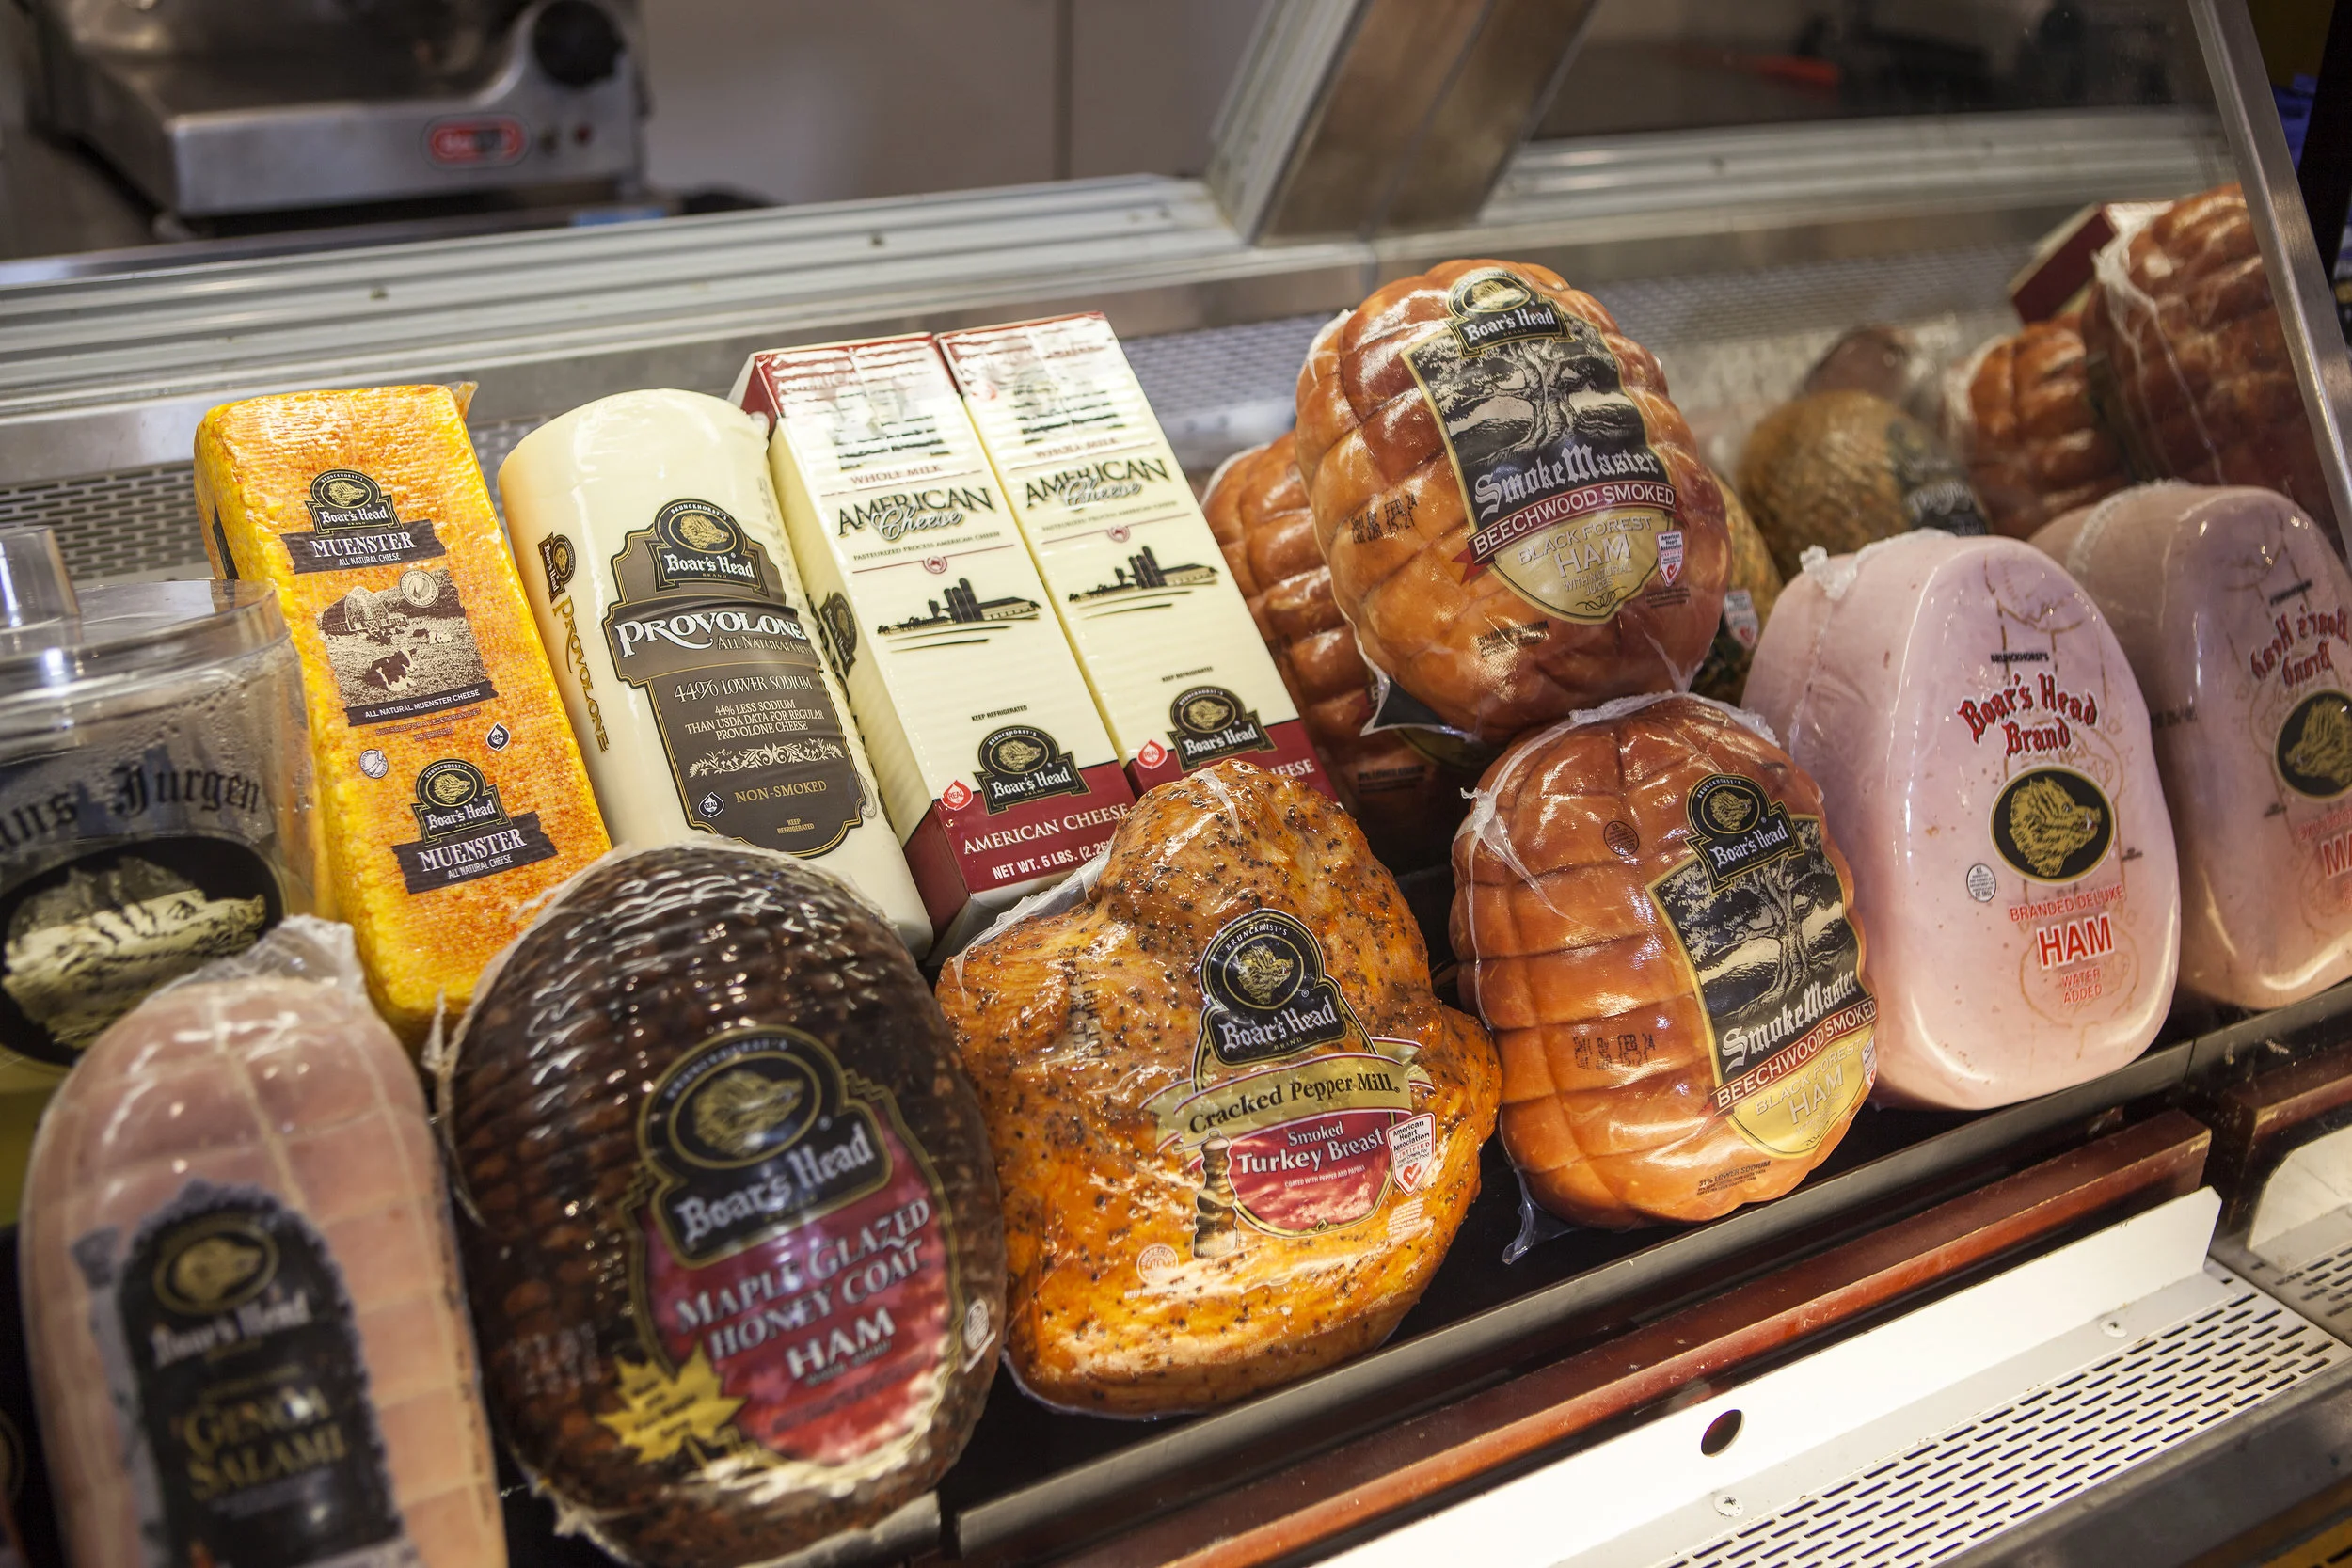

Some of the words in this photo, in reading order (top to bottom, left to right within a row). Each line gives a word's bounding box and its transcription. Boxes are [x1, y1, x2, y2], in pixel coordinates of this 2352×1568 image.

[1464, 314, 1515, 342] Boar's
[1515, 308, 1555, 326] Head
[850, 470, 901, 484] WHOLE
[907, 464, 943, 476] MILK
[1025, 458, 1172, 509] AMERICAN
[1475, 444, 1659, 520] SmokeMaster
[320, 509, 358, 524] Boar's
[358, 507, 389, 520] Head
[838, 487, 995, 536] AMERICAN
[871, 505, 962, 541] Cheese
[1474, 490, 1598, 555] BEECHWOOD
[1602, 483, 1676, 508] SMOKED
[310, 531, 417, 558] MUENSTER
[853, 546, 902, 561] PASTEURIZED
[902, 541, 935, 552] PROCESS
[1517, 530, 1578, 565] BLACK
[1581, 516, 1652, 541] FOREST
[1553, 533, 1632, 578] HAM
[339, 557, 350, 566] ALL
[351, 555, 378, 565] NATURAL
[378, 553, 401, 562] CHEESE
[544, 544, 555, 571] Boar's
[664, 554, 717, 573] Boar's
[718, 556, 755, 578] Head
[1564, 577, 1592, 593] WITH
[1590, 564, 1633, 583] NATURAL
[1585, 578, 1613, 595] JUICES
[615, 611, 807, 657] PROVOLONE
[718, 636, 739, 650] ALL
[552, 595, 610, 753] PROVOLONE
[675, 679, 719, 703] 44%
[722, 675, 769, 695] LOWER
[770, 675, 813, 691] SODIUM
[365, 709, 379, 718] ALL
[380, 704, 414, 716] NATURAL
[414, 696, 453, 710] MUENSTER
[453, 689, 480, 702] CHEESE
[715, 705, 735, 716] 44%
[736, 702, 757, 714] LESS
[758, 699, 796, 712] SODIUM
[987, 705, 1028, 719] REFRIGERATED
[1957, 671, 2034, 745] Boar's
[2038, 672, 2098, 727] Head
[685, 721, 715, 735] THAN
[716, 717, 744, 730] USDA
[744, 713, 770, 725] DATA
[771, 711, 788, 721] FOR
[789, 709, 825, 721] REGULAR
[716, 724, 775, 741] PROVOLONE
[775, 721, 808, 732] CHEESE
[2001, 716, 2071, 758] Brand
[1183, 735, 1225, 756] Boar's
[1223, 723, 1259, 745] Head
[110, 764, 261, 819] Jurgen
[734, 781, 827, 803] NON-SMOKED
[948, 790, 963, 800] REAL
[991, 777, 1035, 800] Boar's
[1033, 766, 1072, 788] Head
[425, 810, 466, 831] Boar's
[464, 800, 496, 819] Head
[704, 801, 717, 810] REAL
[777, 823, 815, 834] REFRIGERATED
[963, 819, 1061, 855] AMERICAN
[1063, 803, 1129, 830] CHEESE
[1709, 836, 1757, 869] Boar's
[1753, 819, 1788, 849] Head
[418, 828, 527, 872] MUENSTER
[992, 863, 1016, 880] NET
[1016, 859, 1041, 875] WT.
[1043, 855, 1051, 867] 5
[1051, 849, 1078, 865] LBS.
[448, 868, 460, 879] ALL
[460, 860, 489, 877] NATURAL
[489, 854, 513, 868] CHEESE
[2010, 897, 2075, 923] BRANDED
[2077, 885, 2125, 908] DELUXE
[2036, 911, 2116, 971] HAM
[2061, 966, 2102, 988] WATER
[2063, 983, 2103, 1004] ADDED
[1218, 1012, 1286, 1053] Boar's
[1284, 994, 1338, 1035] Head
[1723, 970, 1857, 1074] SmokeMaster
[1273, 1037, 1302, 1051] BRAND
[1717, 1028, 1824, 1108] BEECHWOOD
[1826, 1000, 1877, 1037] SMOKED
[1756, 1072, 1811, 1116] BLACK
[1813, 1038, 1863, 1081] FOREST
[1189, 1089, 1284, 1134] Cracked
[1290, 1076, 1354, 1101] Pepper
[1788, 1064, 1844, 1125] HAM
[1288, 1120, 1344, 1147] Smoked
[1393, 1120, 1424, 1136] American
[1393, 1132, 1430, 1152] Association
[1399, 1129, 1418, 1141] Heart
[1237, 1148, 1322, 1174] Turkey
[1327, 1128, 1385, 1162] Breast
[674, 1163, 792, 1250] Boar's
[785, 1120, 875, 1188] Head
[1285, 1179, 1304, 1188] COATED
[1305, 1177, 1318, 1185] WITH
[1319, 1173, 1337, 1181] PEPPER
[1714, 1168, 1740, 1182] LOWER
[1740, 1160, 1771, 1174] SODIUM
[675, 1259, 803, 1334] MAPLE
[808, 1197, 930, 1280] GLAZED
[709, 1284, 833, 1360] HONEY
[842, 1237, 922, 1304] COAT
[786, 1306, 896, 1380] HAM
